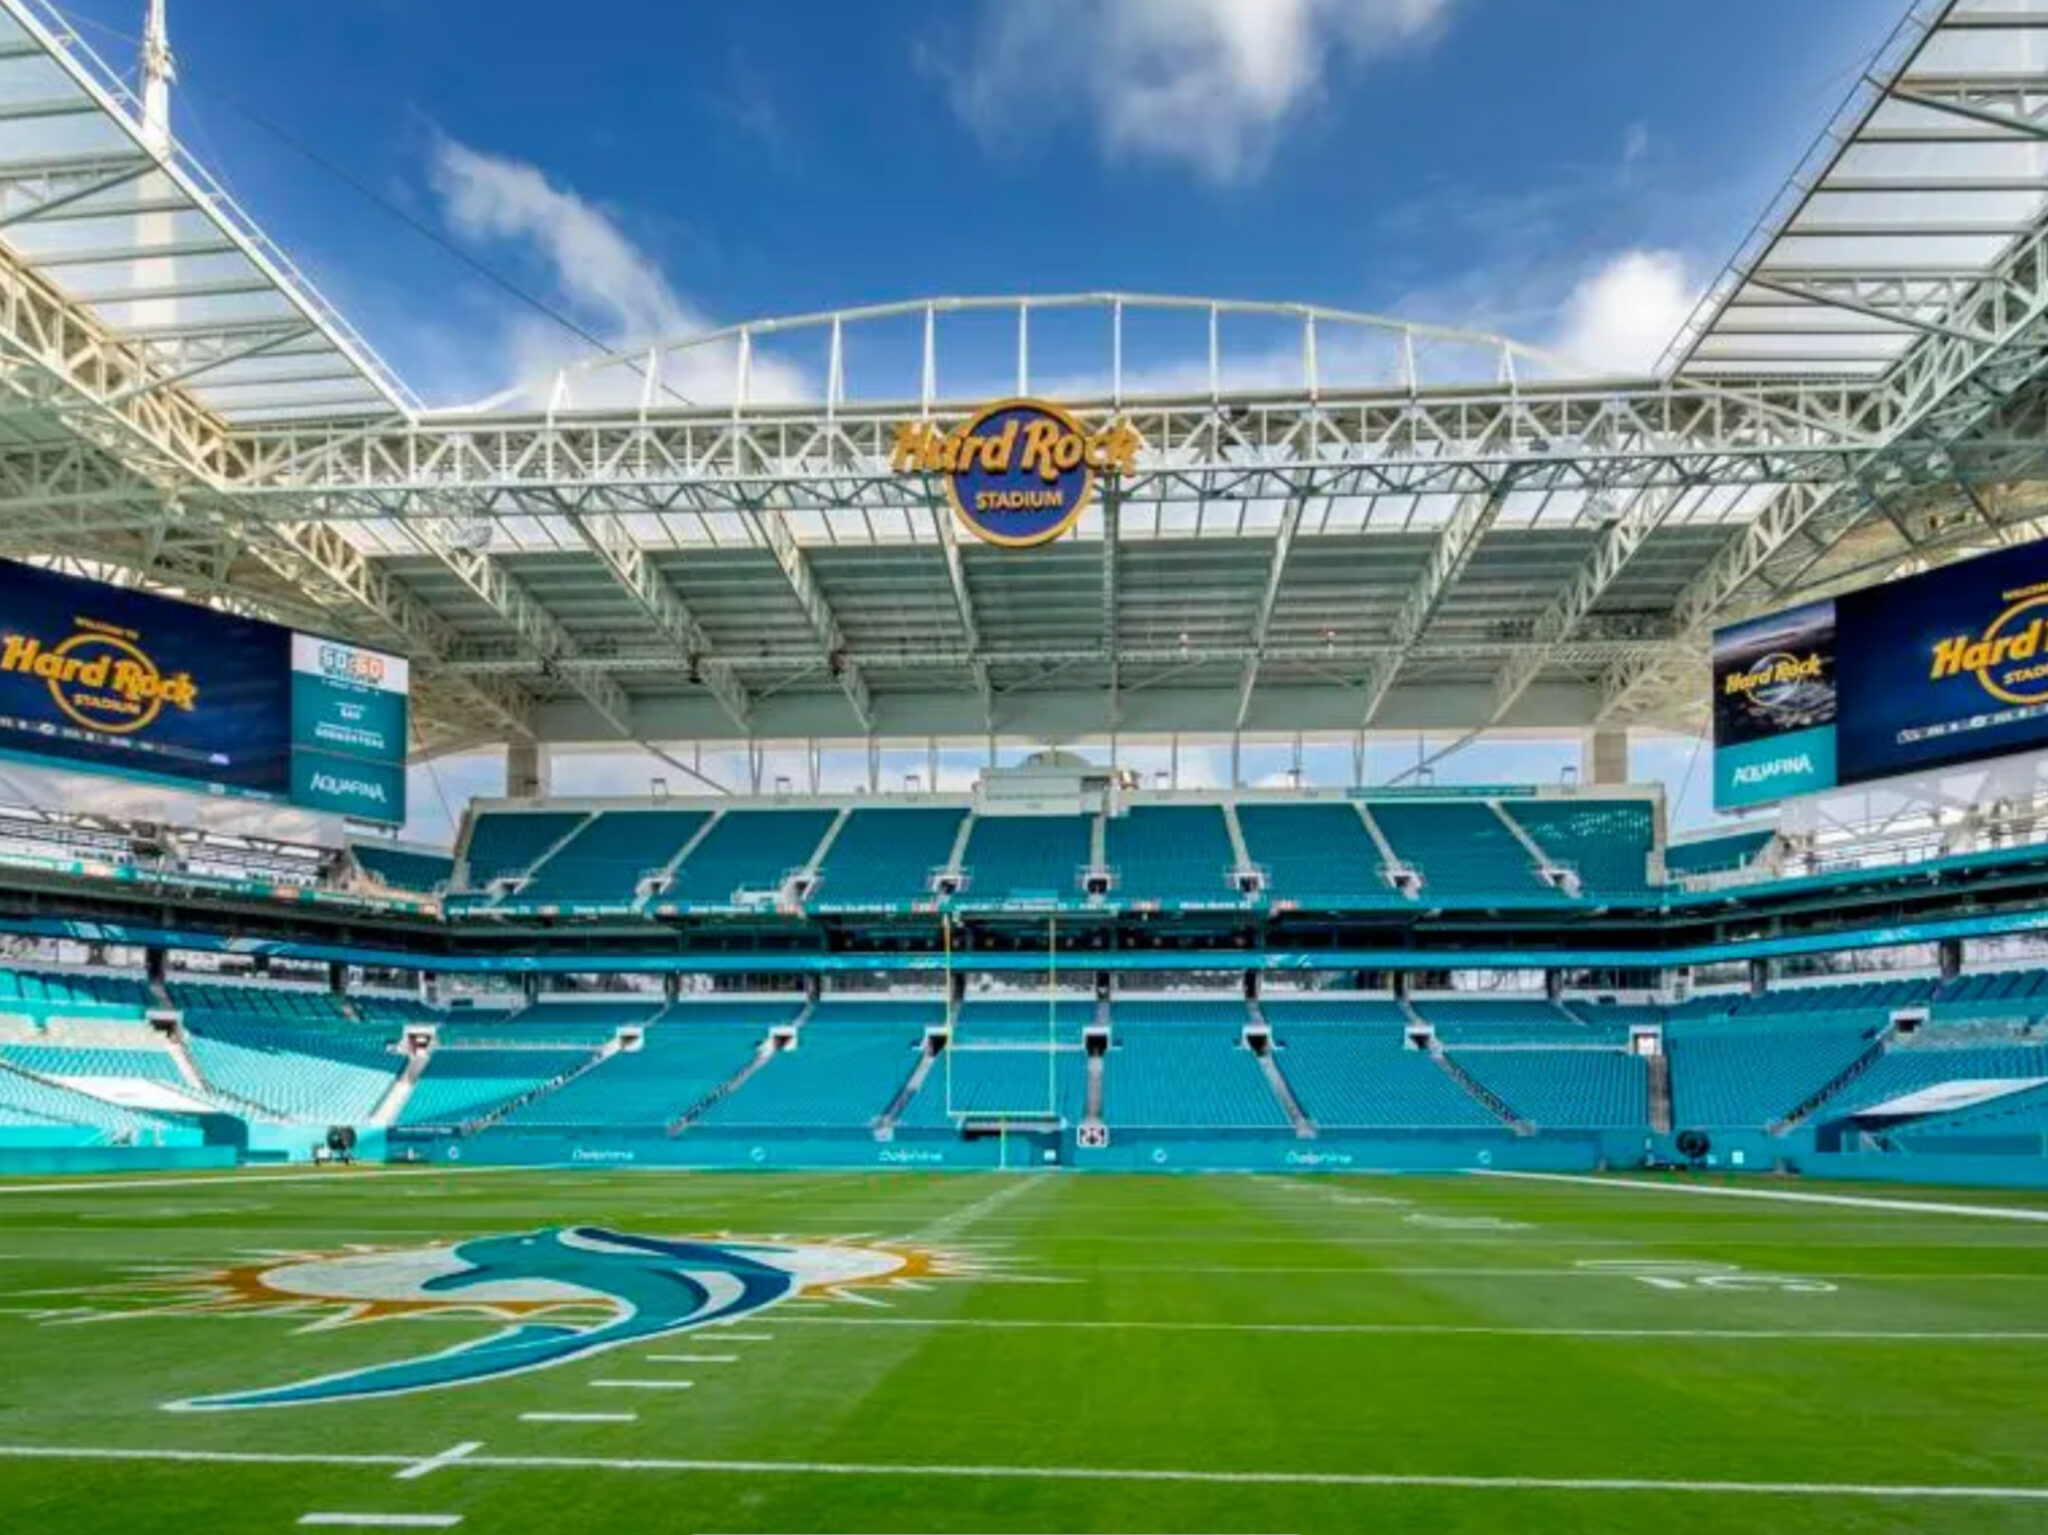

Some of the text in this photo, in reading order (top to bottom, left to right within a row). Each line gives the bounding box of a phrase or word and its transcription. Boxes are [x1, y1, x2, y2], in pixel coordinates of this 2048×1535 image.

[891, 416, 1138, 481] Hard Rock
[976, 490, 1062, 511] STADIUM
[1930, 619, 2043, 679] Hard
[1, 634, 199, 711] Hard Rock
[1725, 664, 1774, 694] Hard
[1775, 653, 1821, 682] Rock
[311, 772, 387, 803] AQUAFINA
[1732, 753, 1814, 788] AQUAFINA
